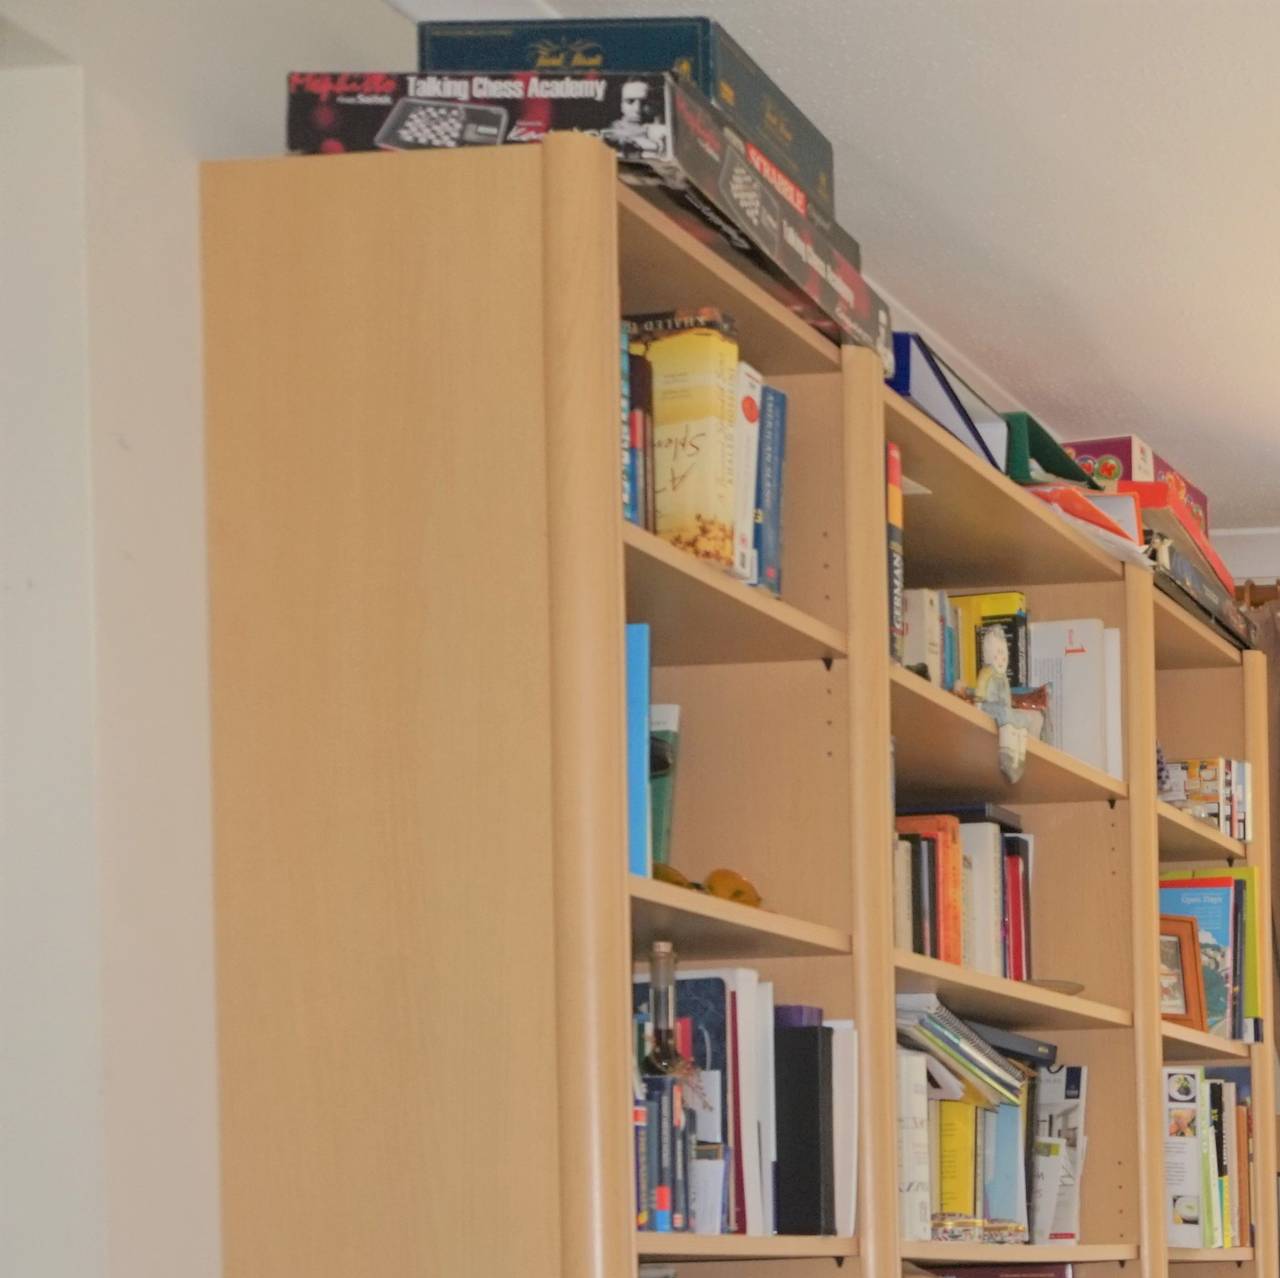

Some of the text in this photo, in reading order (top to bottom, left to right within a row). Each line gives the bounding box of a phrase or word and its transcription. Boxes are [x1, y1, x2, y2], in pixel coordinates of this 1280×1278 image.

[407, 76, 608, 101] Talking Chess Academy
[892, 553, 902, 628] GERMAN
